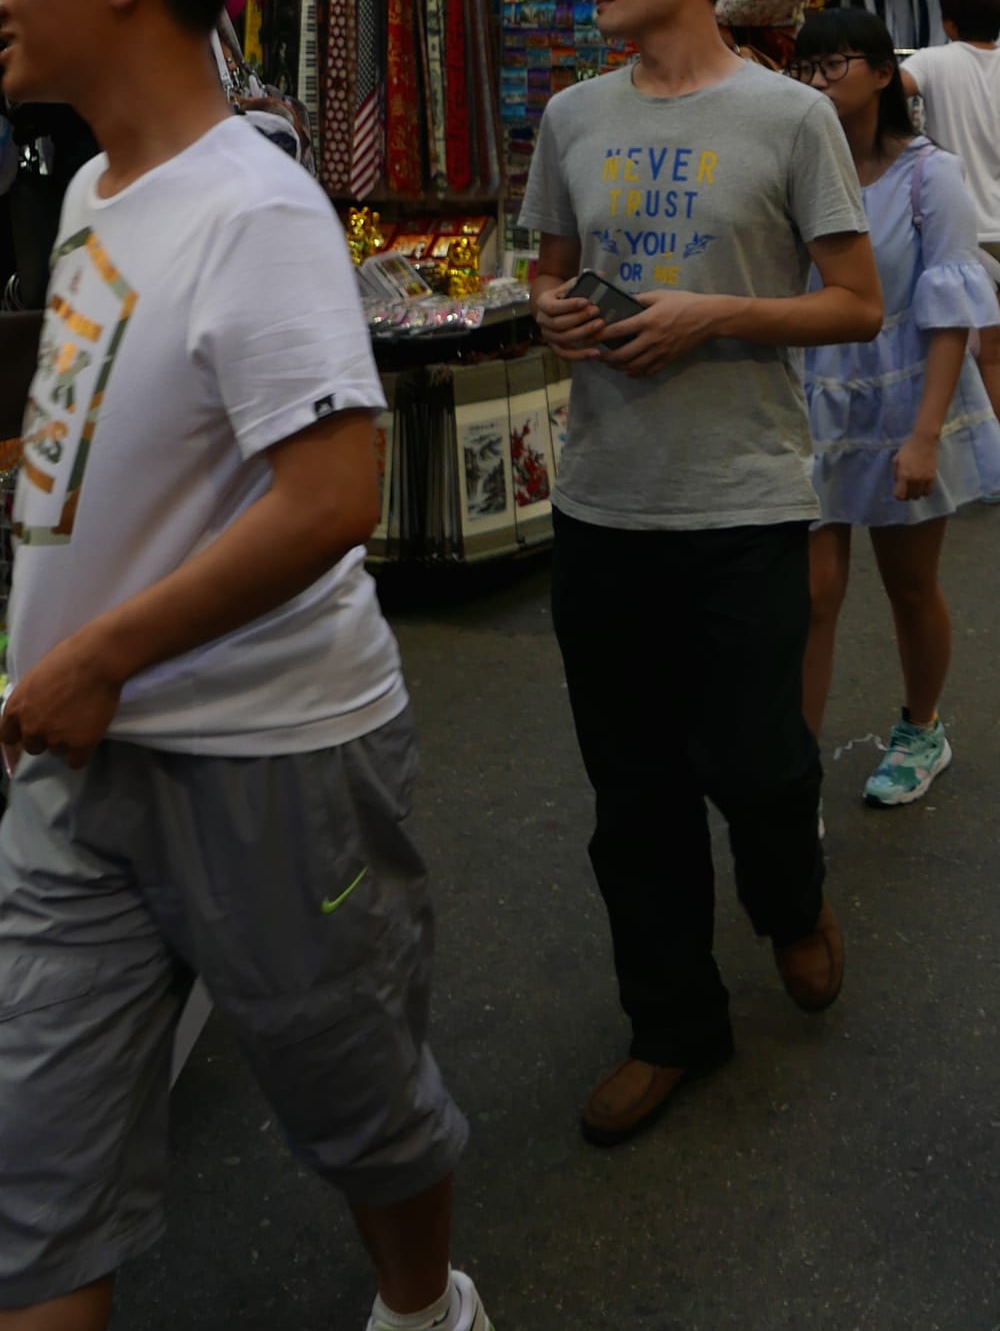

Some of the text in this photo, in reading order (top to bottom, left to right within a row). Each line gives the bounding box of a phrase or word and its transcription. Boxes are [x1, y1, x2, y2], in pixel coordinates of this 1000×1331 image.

[602, 147, 718, 184] NEVER
[609, 188, 698, 219] TRUST
[625, 231, 677, 256] YOU
[620, 262, 680, 285] OR ME
